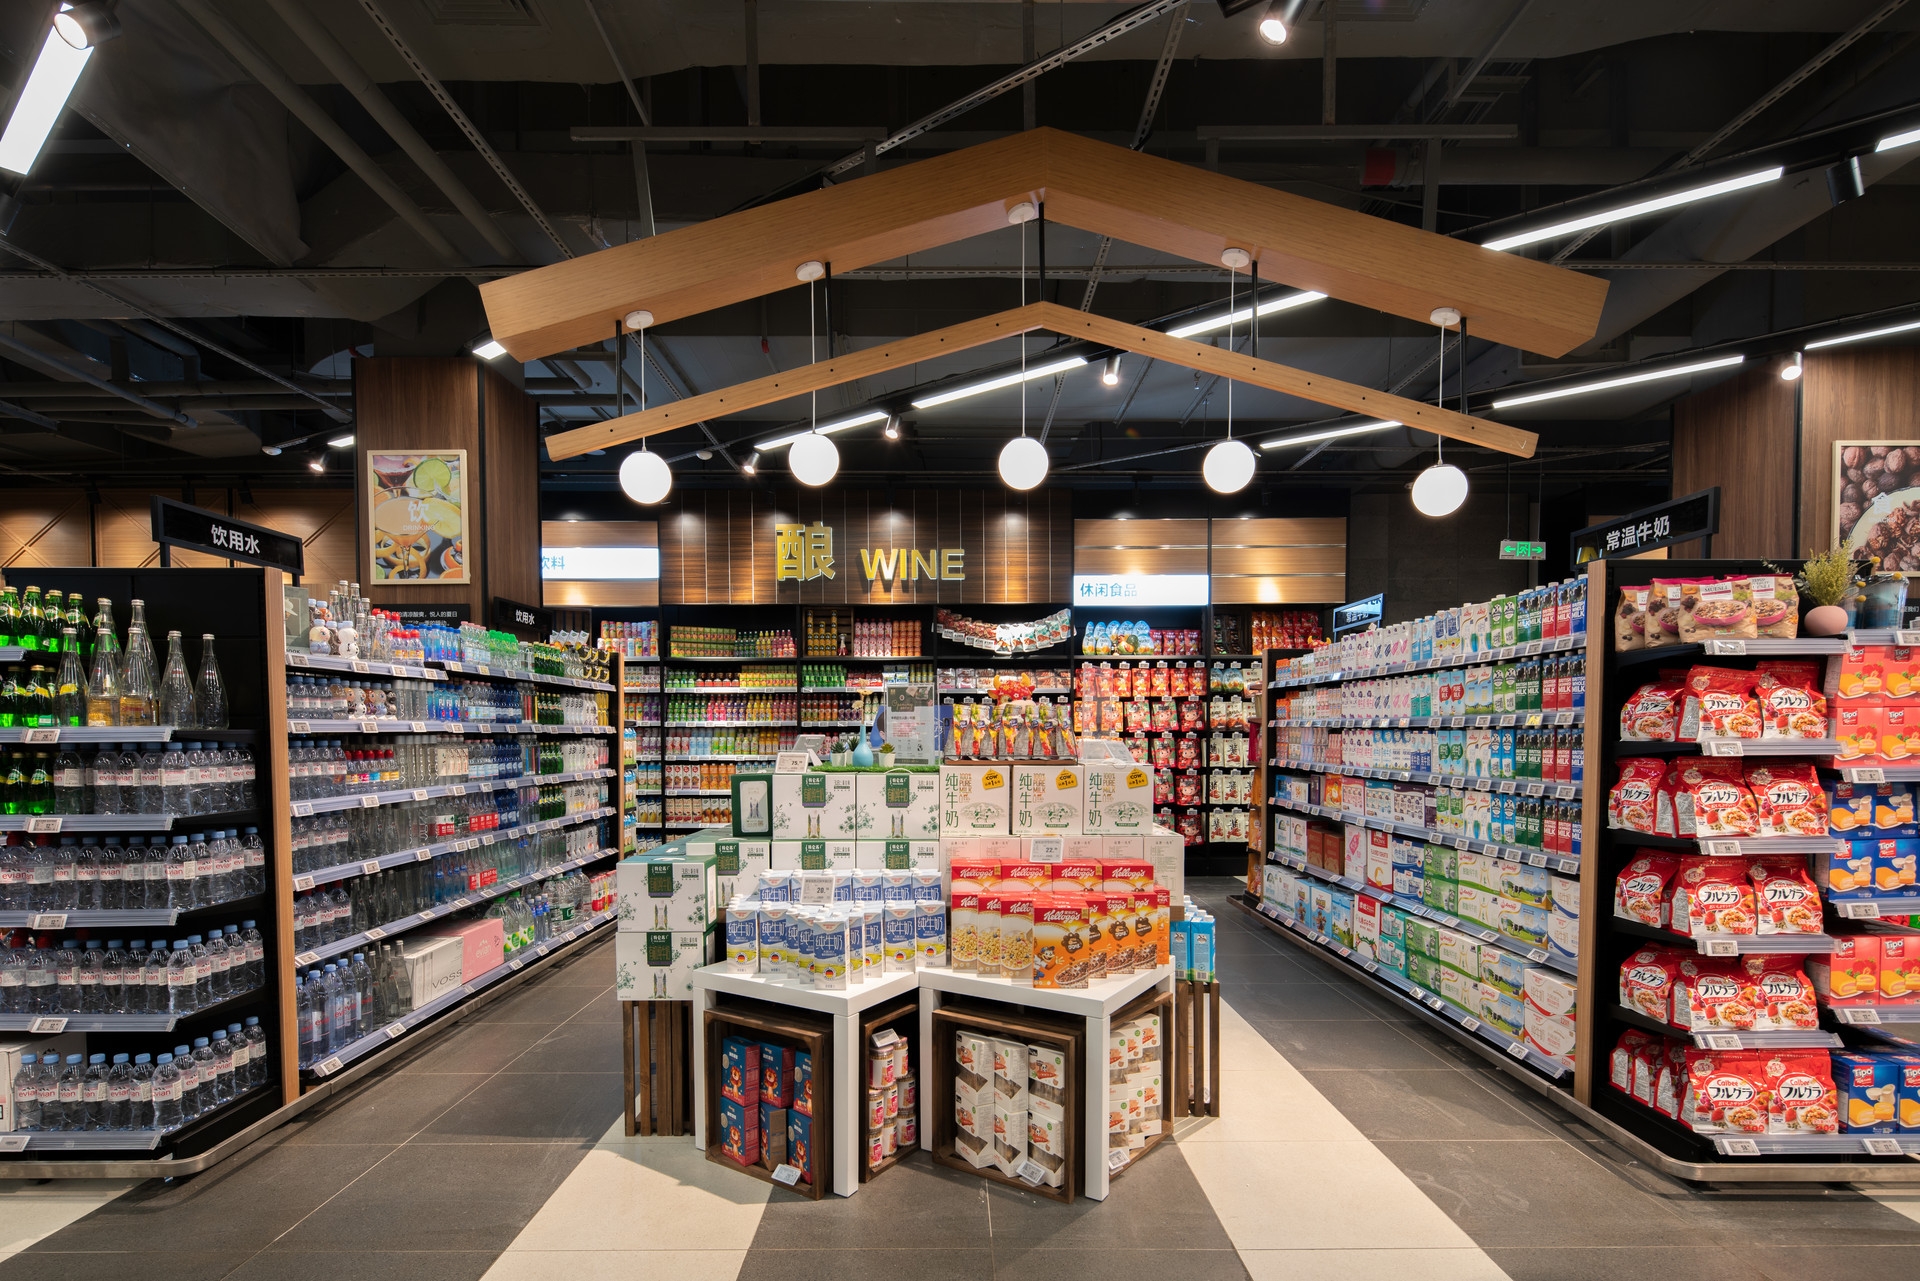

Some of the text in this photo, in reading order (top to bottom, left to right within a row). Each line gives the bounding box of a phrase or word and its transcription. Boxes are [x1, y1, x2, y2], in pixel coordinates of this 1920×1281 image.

[408, 500, 430, 523] 饮
[1606, 515, 1670, 551] 常温牛奶
[210, 524, 261, 555] 饮用水
[775, 521, 836, 581] 酿
[860, 548, 966, 581] WINE
[1080, 582, 1137, 598] 休闲食品
[515, 610, 535, 625] 饮用水
[1572, 610, 1585, 618] MILK
[1842, 711, 1857, 719] Tipo
[1889, 711, 1904, 719] Tipo
[945, 773, 958, 828] 纯牛奶
[1019, 773, 1032, 828] 纯牛奶
[1089, 772, 1102, 827] 纯牛奶
[1700, 791, 1738, 802] フルグラ
[1769, 792, 1808, 803] フルグラ
[1879, 841, 1894, 849] Tipo
[960, 868, 993, 878] Kellogg's
[1010, 868, 1044, 878] Kellogg's
[1061, 868, 1094, 878] Kellogg's
[1112, 868, 1145, 878] Kellogg's
[1704, 891, 1738, 902] フルグラ
[1766, 889, 1804, 900] フルグラ
[1043, 911, 1081, 923] Kellogg's
[729, 922, 753, 936] 纯牛奶
[887, 921, 912, 935] 纯牛奶
[918, 917, 943, 931] 纯牛奶
[816, 935, 842, 950] 纯牛奶
[1885, 940, 1903, 949] Tipo
[432, 968, 463, 989] VOSS
[1698, 984, 1738, 996] フルグラ
[1762, 983, 1800, 995] フルグラ
[1852, 1067, 1872, 1077] Tipo
[1709, 1086, 1753, 1098] フルグラ
[1781, 1086, 1821, 1098] フルグラ
